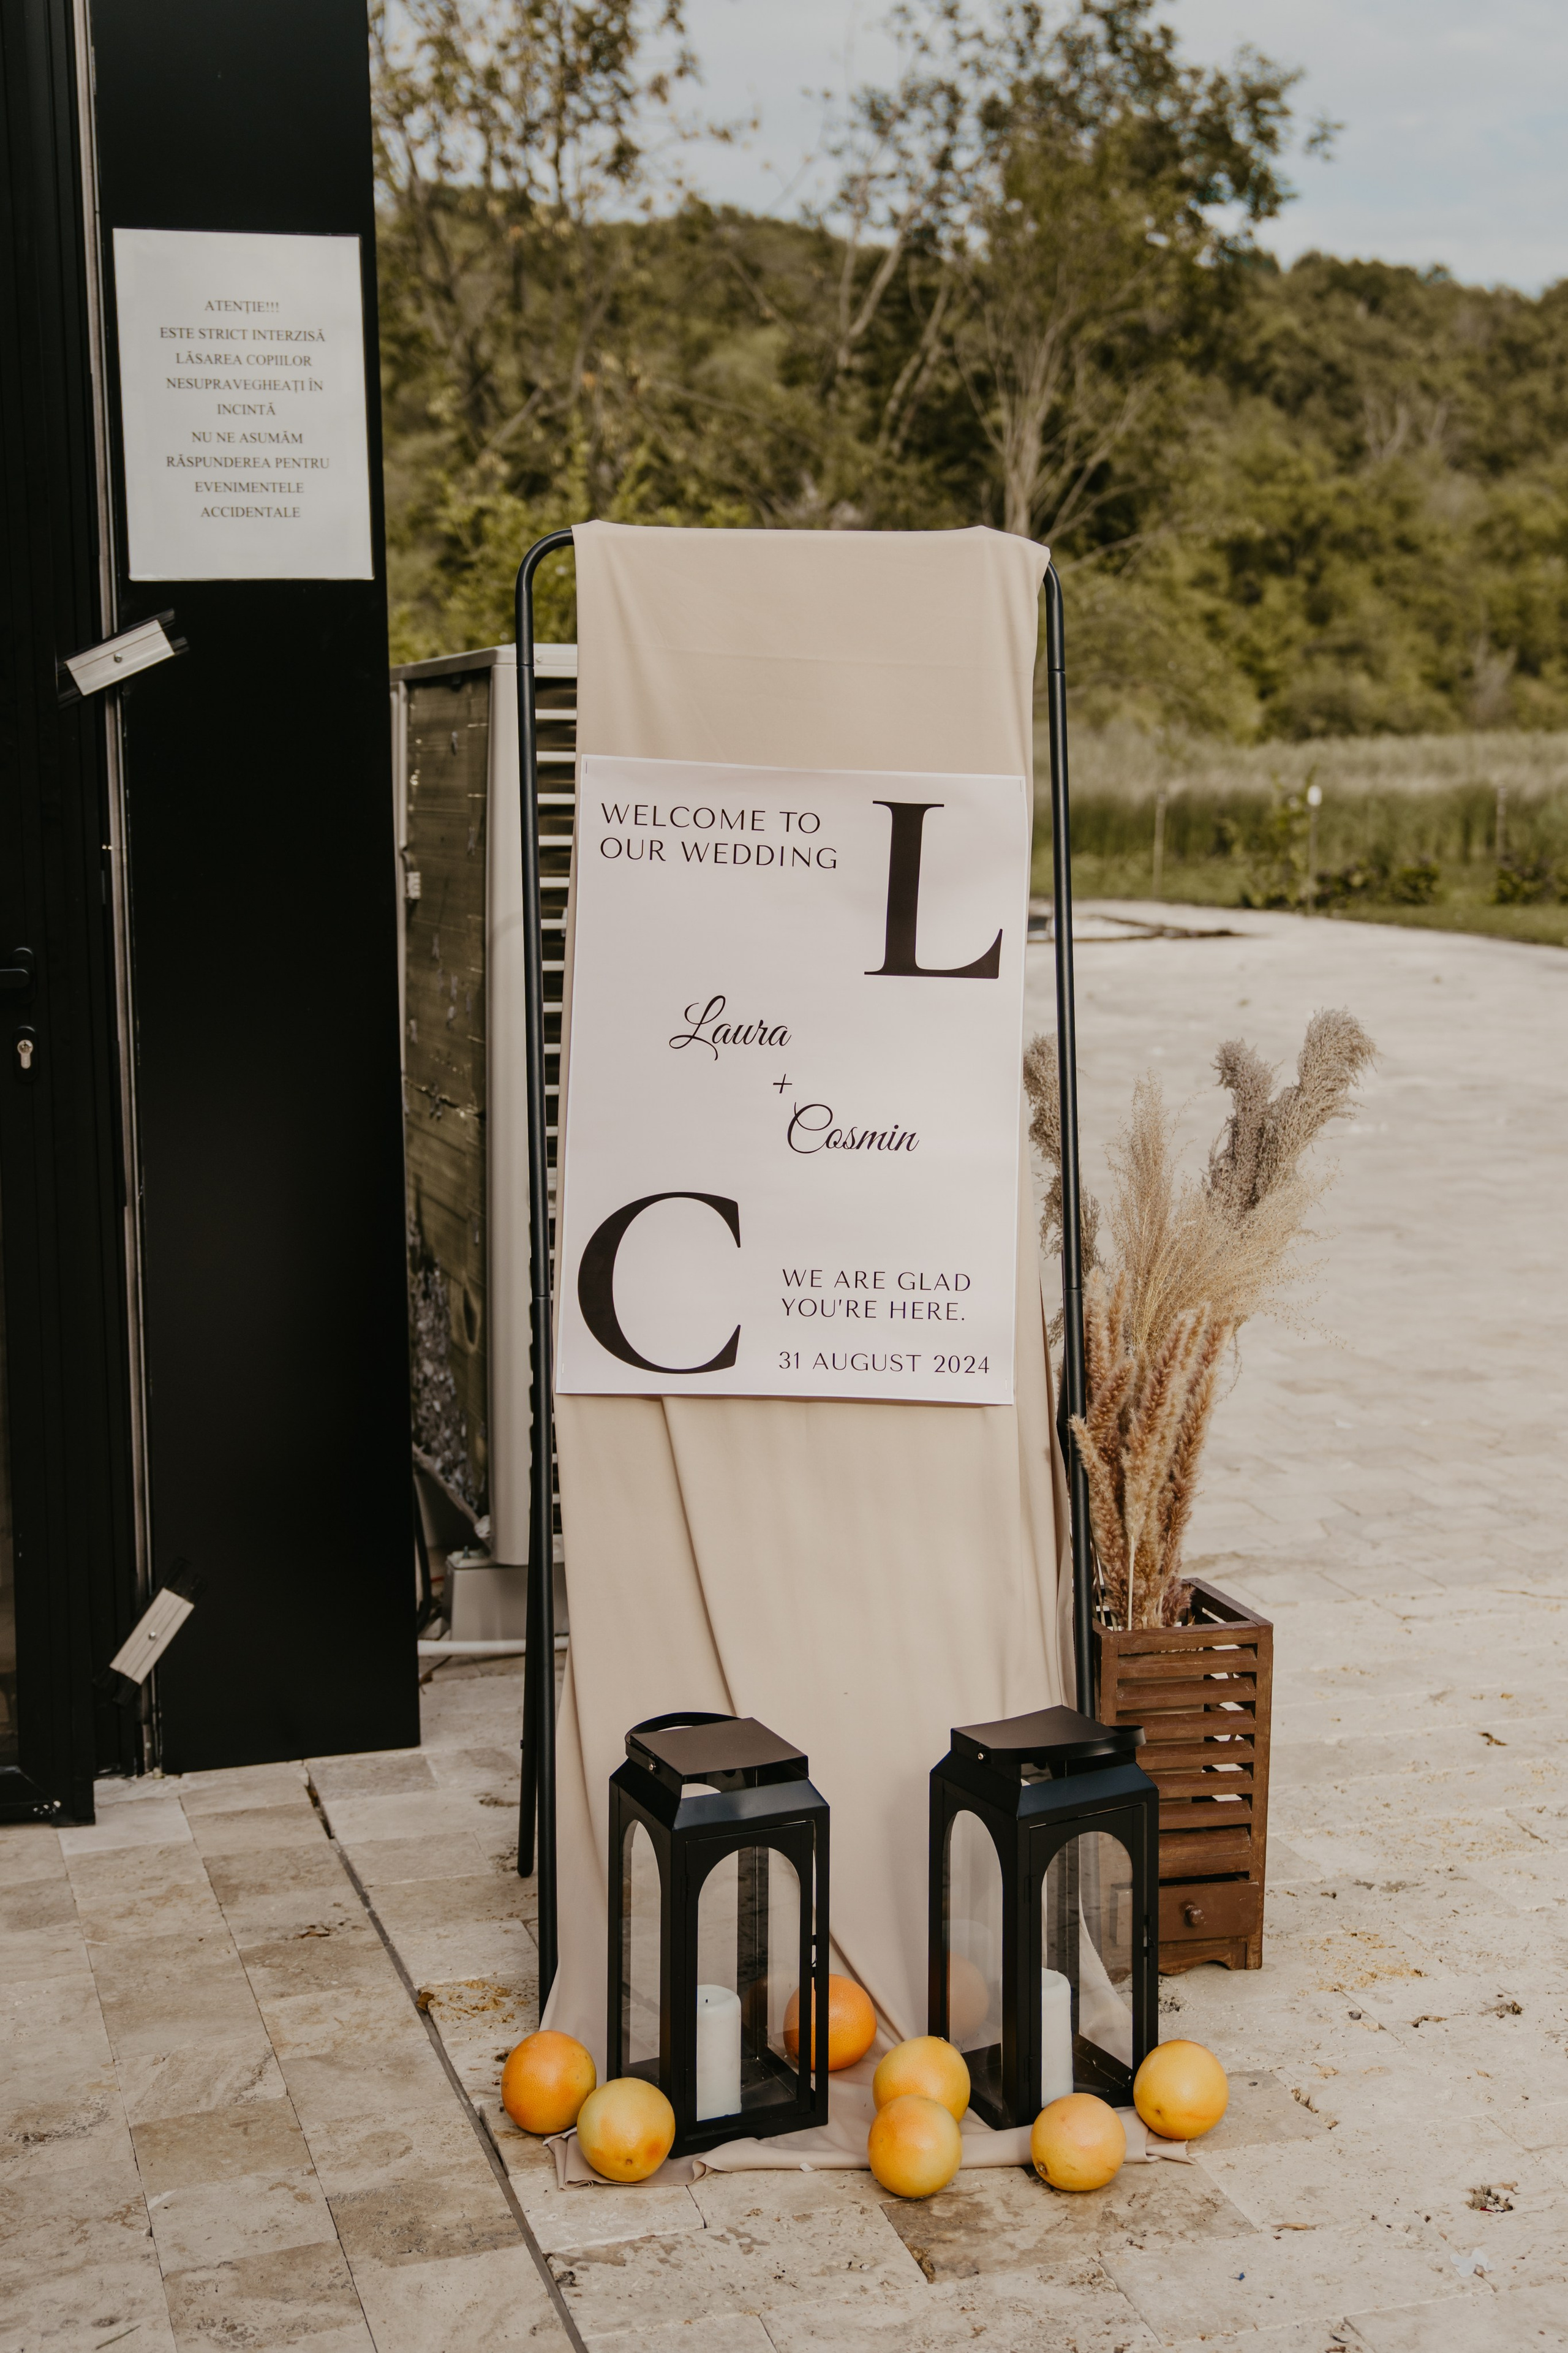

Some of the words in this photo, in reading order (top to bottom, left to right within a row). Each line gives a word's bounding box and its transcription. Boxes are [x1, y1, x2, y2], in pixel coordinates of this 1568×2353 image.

[160, 327, 194, 339] ESTE
[198, 328, 248, 340] STRICT
[252, 328, 325, 342] INTERZISĂ
[175, 350, 243, 365] LĂSAREA
[246, 354, 312, 367] COPIILOR
[309, 377, 323, 391] ÎN
[217, 402, 276, 415] INCINTĂ
[191, 431, 212, 443] NU
[216, 432, 235, 443] NE
[239, 430, 303, 444] ASUMĂM
[166, 453, 271, 468] RĂSPUNDEREA
[275, 457, 330, 469] PENTRU
[195, 481, 303, 493] EVENIMENTELE
[200, 506, 300, 518] ACCIDENTALE
[601, 803, 766, 831] WELCOME
[779, 811, 821, 834] TO
[600, 837, 666, 862] OUR
[680, 841, 837, 869] WEDDING
[864, 800, 1003, 980] L
[669, 995, 792, 1061] Laura
[787, 1101, 920, 1154] Cosmin
[577, 1192, 741, 1375] C
[782, 1269, 823, 1288] WE
[834, 1270, 886, 1290] ARE
[897, 1272, 971, 1291] GLAD
[782, 1298, 877, 1318] YOU'RE
[890, 1301, 965, 1321] HERE.
[778, 1351, 799, 1369] 31
[812, 1352, 922, 1372] AUGUST
[933, 1354, 990, 1374] 2024
